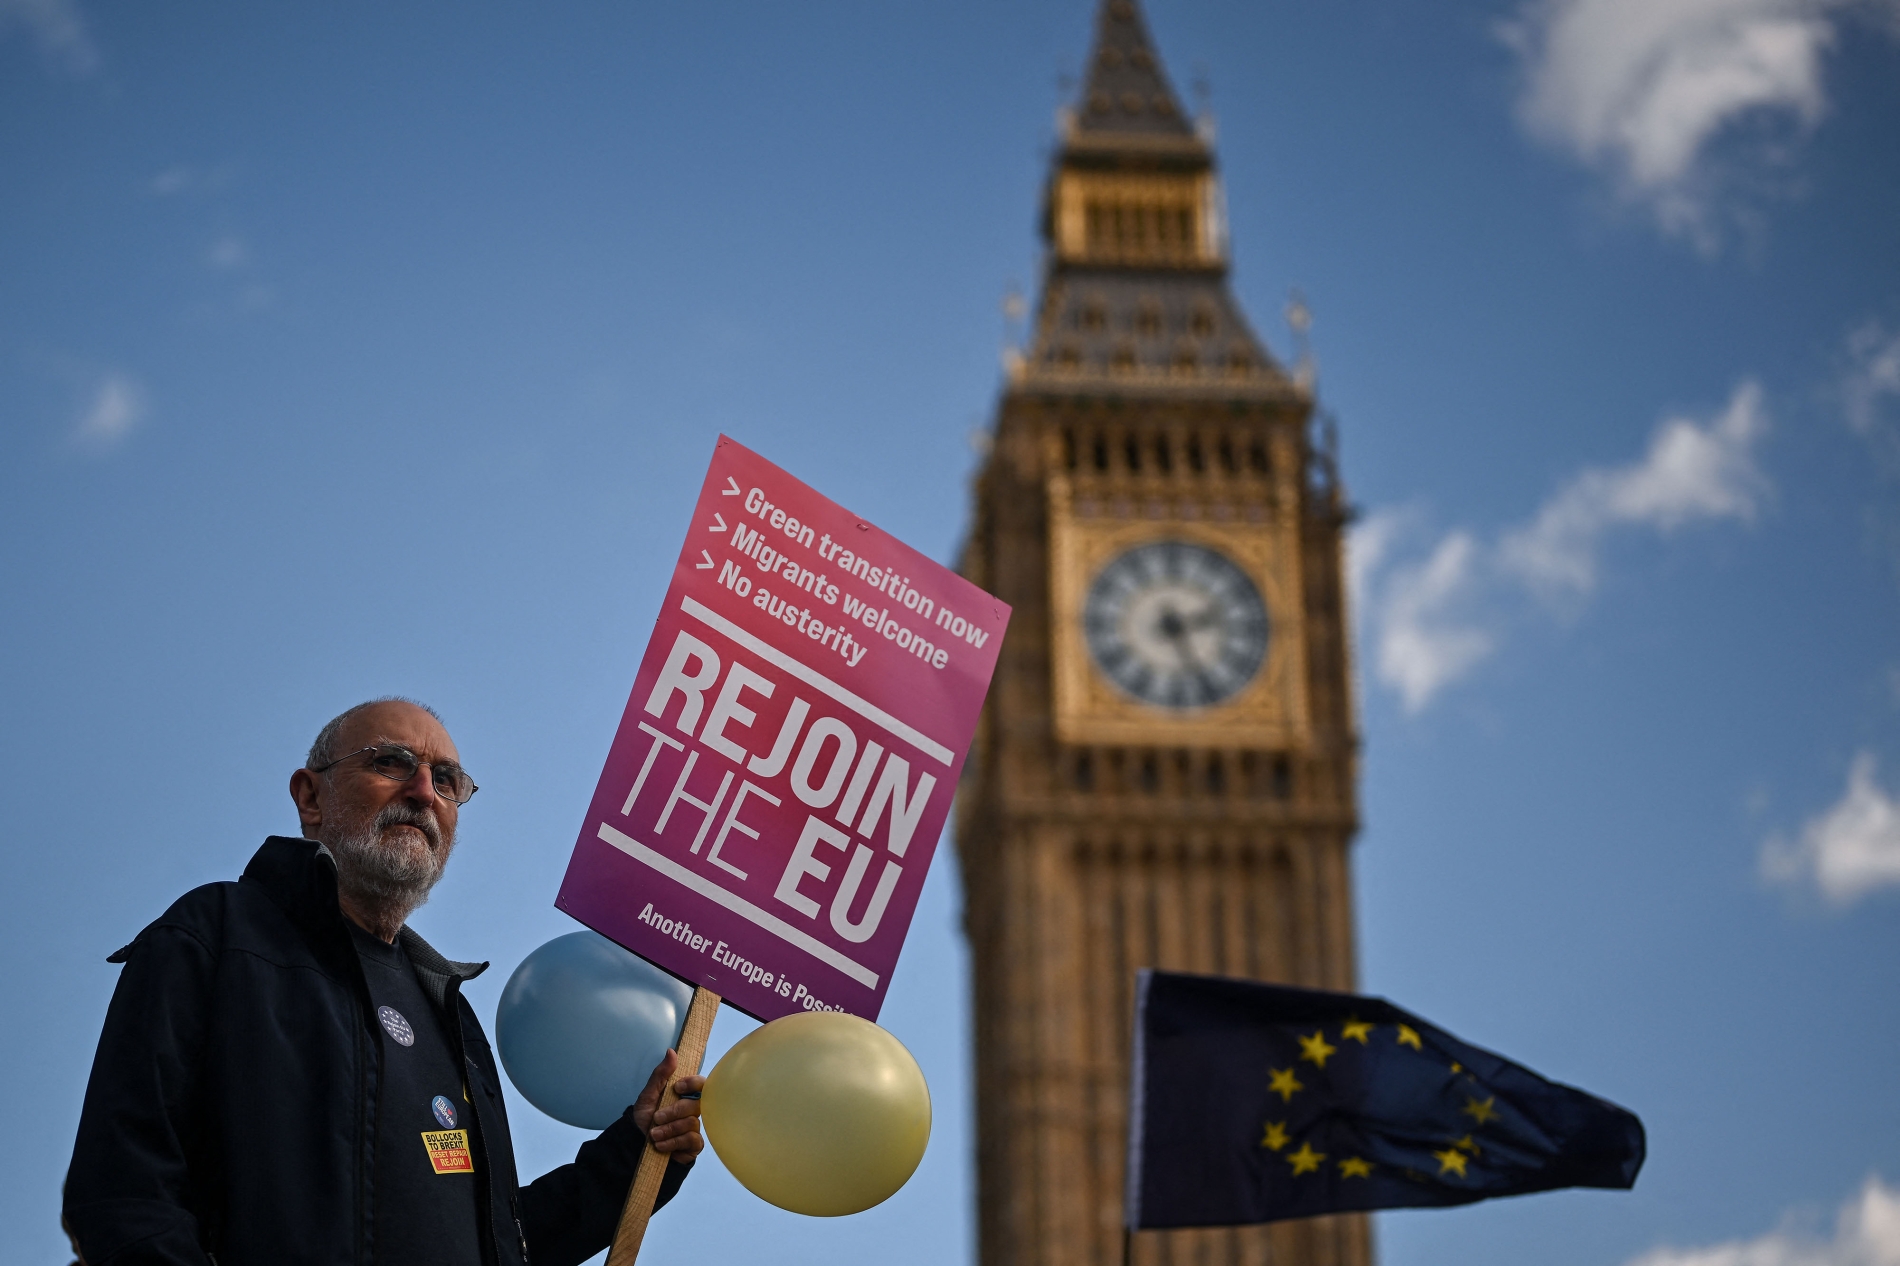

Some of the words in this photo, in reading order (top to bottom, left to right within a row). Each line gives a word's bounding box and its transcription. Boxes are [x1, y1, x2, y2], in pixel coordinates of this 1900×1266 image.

[717, 558, 752, 599] No
[753, 588, 868, 669] austerity
[730, 521, 840, 606] Migrants
[842, 591, 949, 671] welcome
[743, 486, 817, 549] Green
[818, 533, 935, 614] transition
[935, 606, 990, 650] now
[643, 629, 937, 859] REJOIN
[620, 720, 783, 882] THE
[773, 814, 903, 943] EU
[637, 902, 713, 955] Another
[711, 939, 775, 989] Europe
[774, 973, 793, 998] is
[425, 1132, 463, 1142] BOLLOCKS
[428, 1143, 439, 1151] TO
[439, 1141, 464, 1150] BREXIT
[431, 1151, 449, 1159] RESET
[439, 1157, 466, 1167] REJOIN
